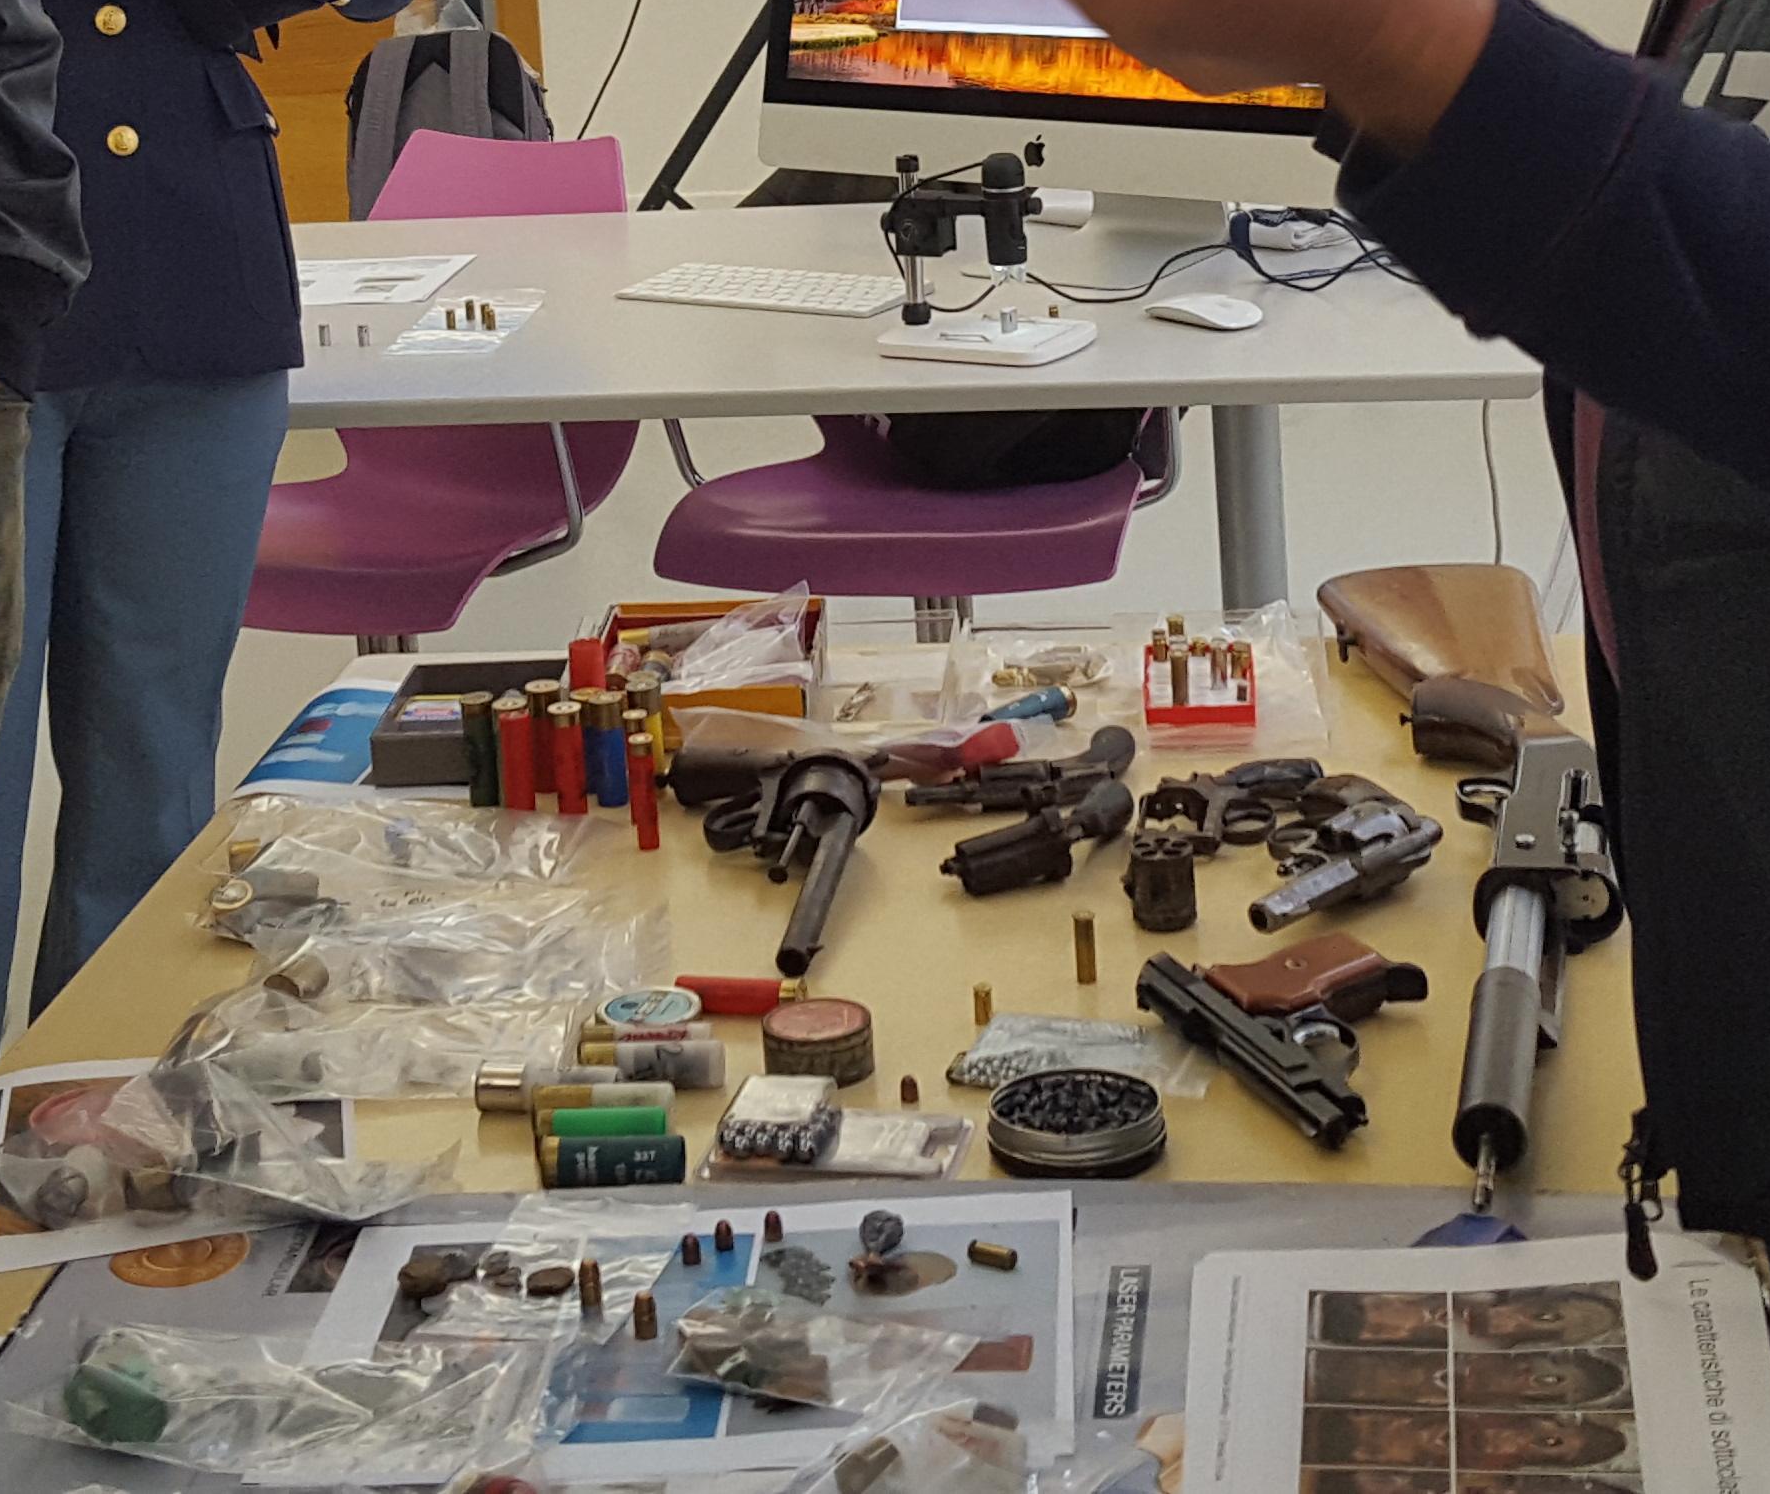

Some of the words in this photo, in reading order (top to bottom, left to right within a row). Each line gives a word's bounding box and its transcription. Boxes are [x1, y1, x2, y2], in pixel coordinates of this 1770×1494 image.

[1688, 1277, 1710, 1298] Le
[1104, 1316, 1136, 1416] PARAMETERS
[1692, 1300, 1727, 1408] caratteristiche
[1708, 1410, 1733, 1426] di
